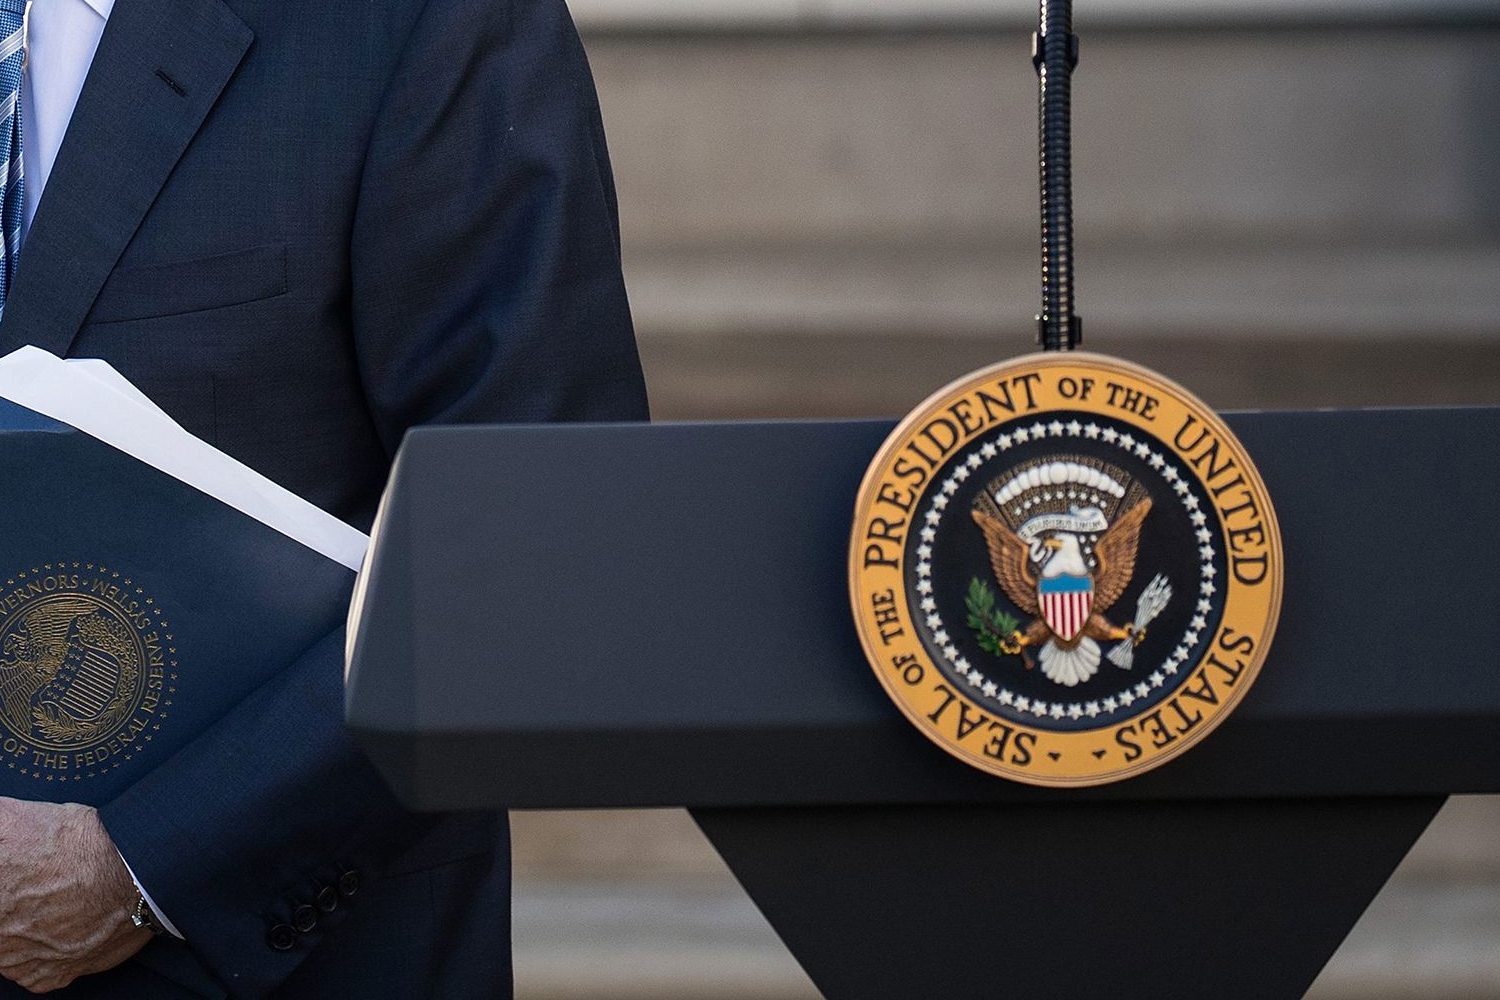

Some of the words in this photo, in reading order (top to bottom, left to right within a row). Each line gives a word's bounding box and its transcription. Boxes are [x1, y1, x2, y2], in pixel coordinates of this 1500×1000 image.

[1058, 378, 1095, 400] OF
[1106, 382, 1159, 420] THE
[864, 373, 1041, 570] PRESIDENT
[1174, 414, 1268, 586] UNITED
[92, 578, 151, 629] SYSTEM
[872, 588, 905, 646] THE
[141, 632, 164, 713] RESERVE
[892, 653, 924, 687] OF
[1115, 628, 1254, 762] STATES
[3, 738, 28, 757] OF
[75, 718, 149, 768] FEDERAL
[927, 683, 1038, 766] SEAL
[33, 752, 68, 769] THE
